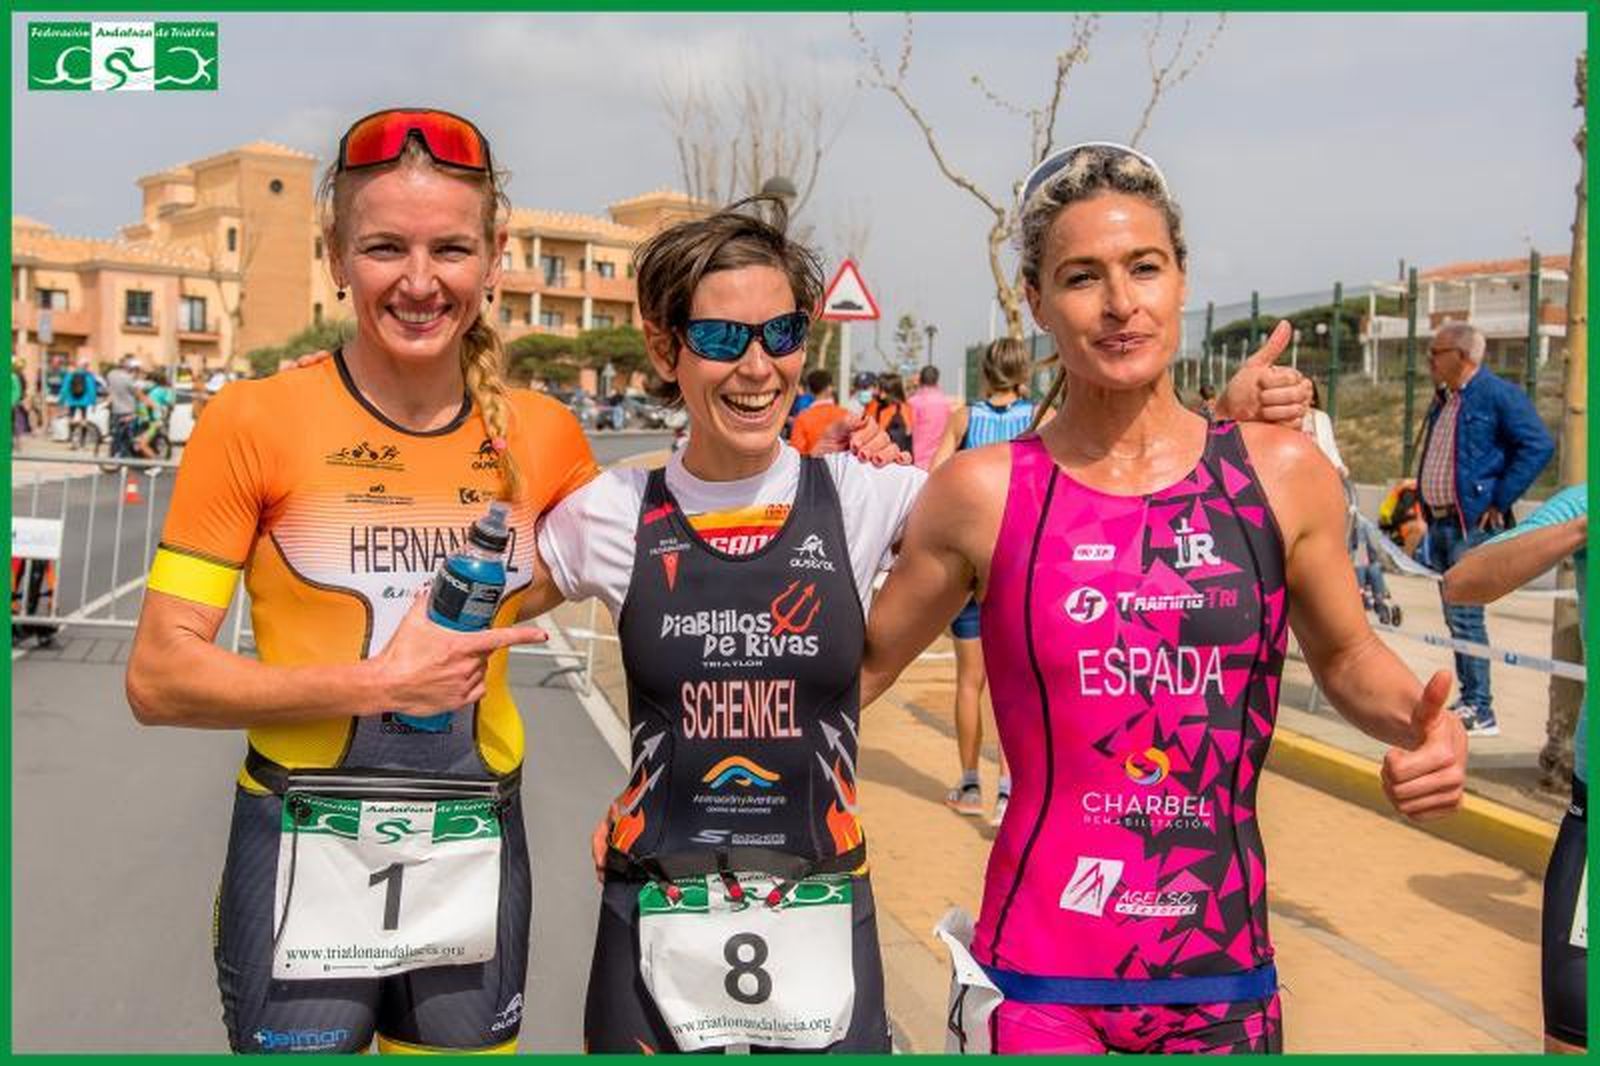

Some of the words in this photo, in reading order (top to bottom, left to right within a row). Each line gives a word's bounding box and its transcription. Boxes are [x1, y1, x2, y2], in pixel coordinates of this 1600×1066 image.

[350, 526, 519, 573] HERNANZ
[1078, 646, 1224, 696] ESPADA
[682, 680, 802, 739] SCHENKEL
[1082, 792, 1212, 818] CHARBEL
[368, 862, 404, 931] 1
[724, 933, 773, 1004] 8
